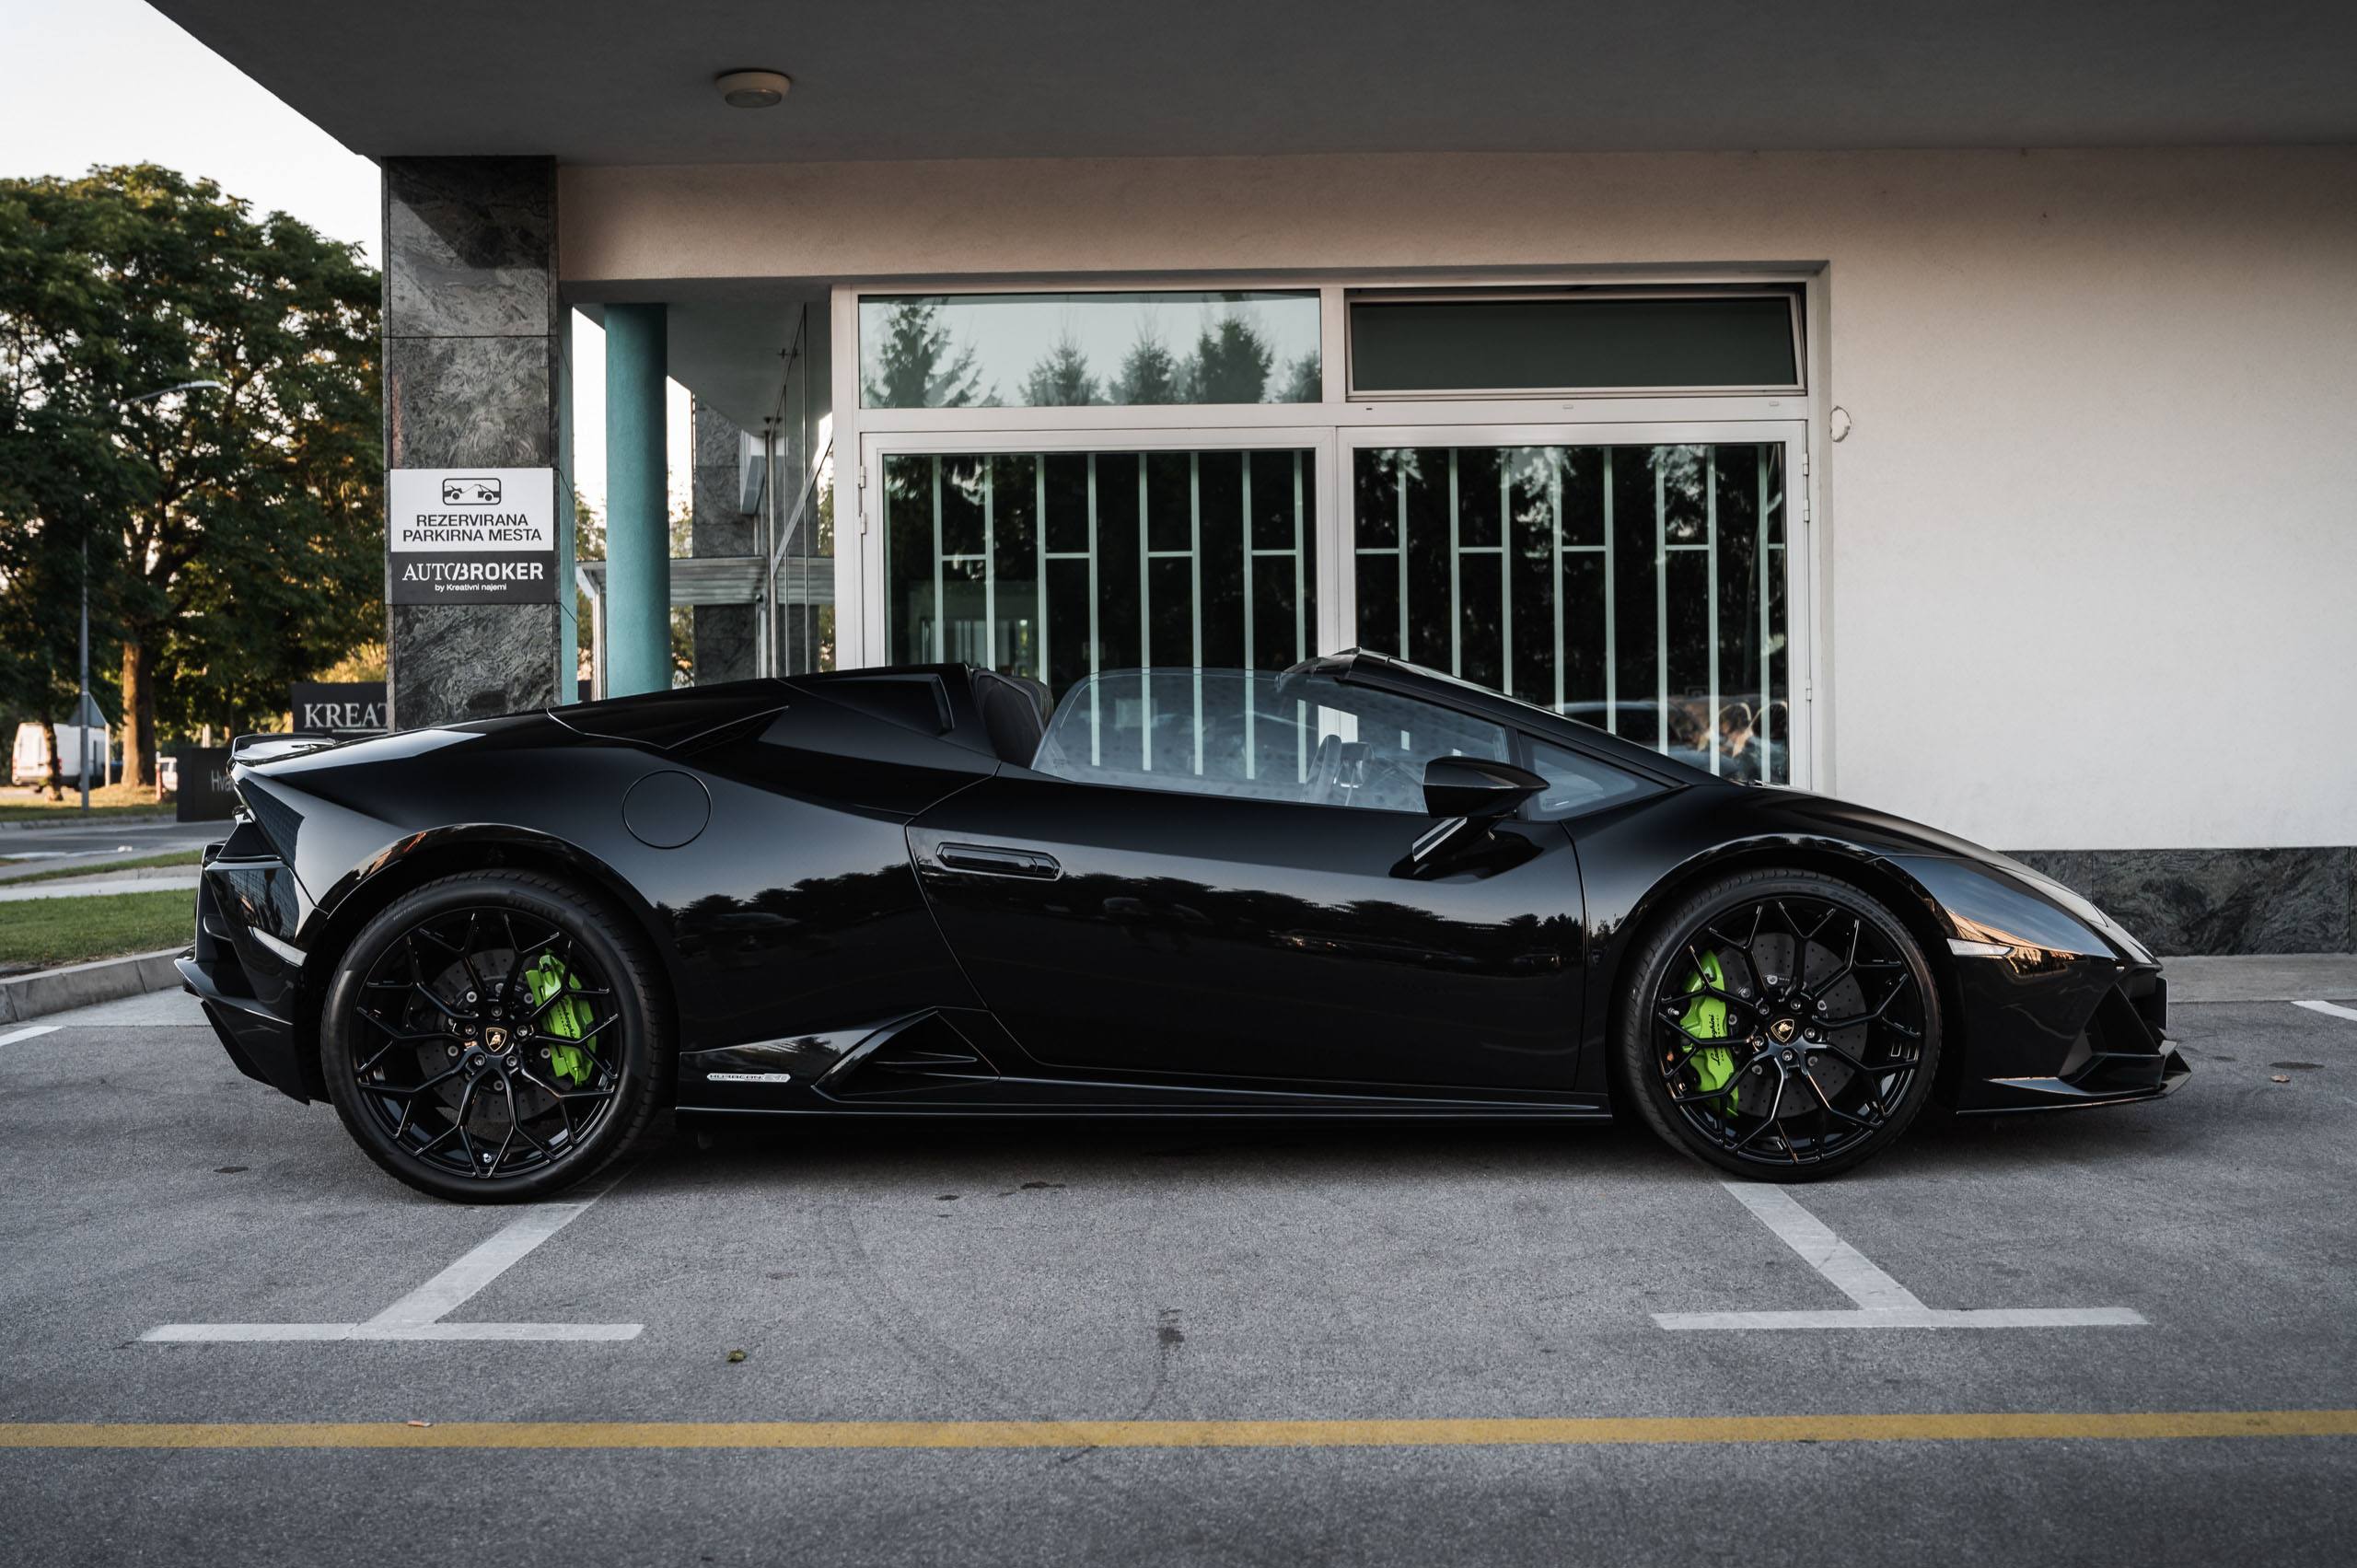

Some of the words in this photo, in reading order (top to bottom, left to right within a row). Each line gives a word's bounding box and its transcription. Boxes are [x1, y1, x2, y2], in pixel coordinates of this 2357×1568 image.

[416, 514, 528, 527] REZERVIRANA
[403, 529, 483, 541] PARKIRNA
[489, 528, 541, 541] MESTA
[435, 584, 445, 592] by
